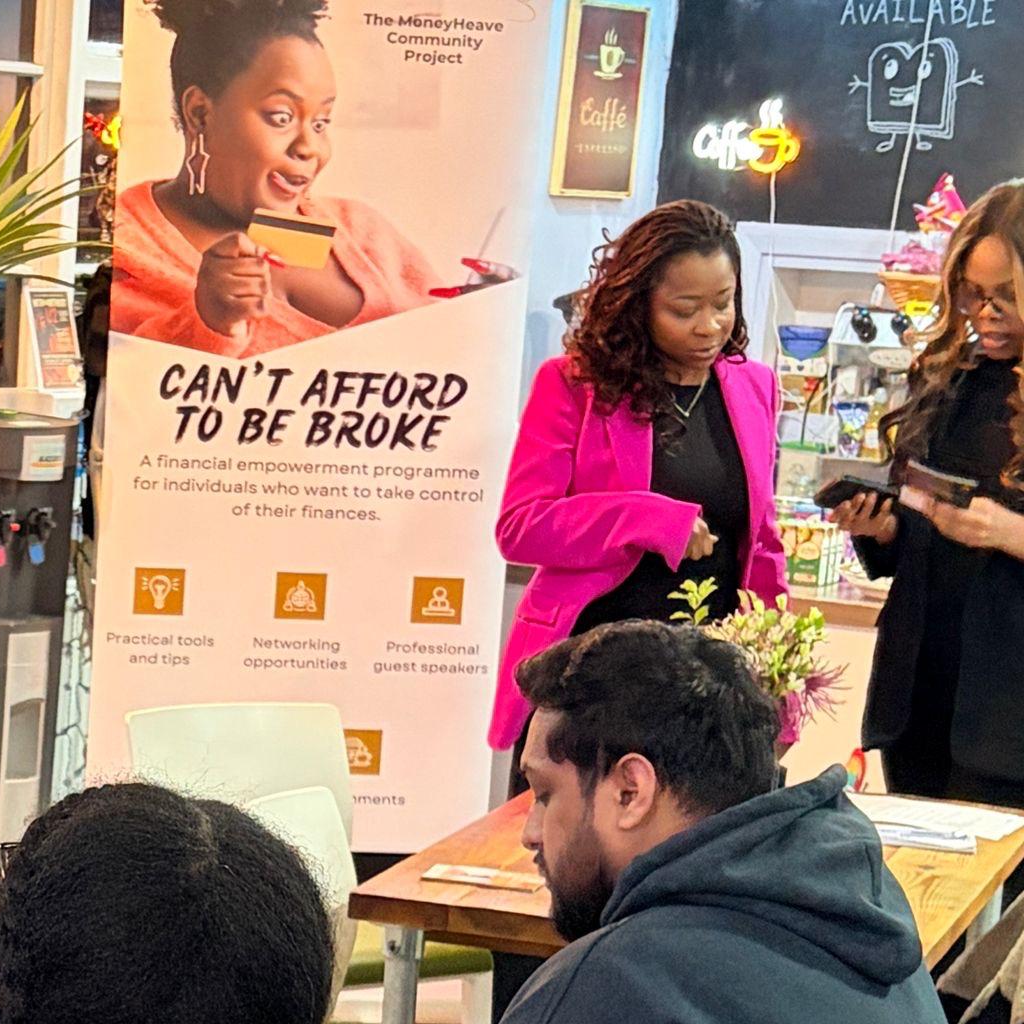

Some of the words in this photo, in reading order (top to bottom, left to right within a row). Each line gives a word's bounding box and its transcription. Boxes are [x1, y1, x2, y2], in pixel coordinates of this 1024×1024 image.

[363, 13, 394, 26] The
[398, 15, 504, 32] MoneyHeave
[840, 0, 996, 29] AVAILABLE
[387, 31, 483, 51] Community
[404, 49, 463, 66] Project
[579, 97, 627, 132] Caffé
[159, 362, 295, 407] CAN'T
[300, 369, 468, 412] AFFORD
[173, 405, 222, 445] TO
[237, 407, 295, 447] BE
[304, 410, 452, 452] BROKE
[139, 455, 152, 469] A
[157, 455, 232, 473] financial
[236, 458, 369, 478] empowerment
[373, 464, 480, 482] programme
[133, 477, 159, 491] for
[163, 477, 258, 496] individuals
[261, 480, 299, 497] who
[304, 484, 349, 499] want
[353, 485, 372, 499] to
[376, 486, 415, 501] take
[419, 488, 484, 503] control
[231, 502, 251, 517] of
[255, 503, 297, 519] their
[301, 505, 381, 521] finances.
[106, 632, 173, 647] Practical
[177, 634, 215, 648] tools
[252, 637, 341, 654] Networking
[386, 641, 480, 655] Professional
[128, 651, 158, 665] and
[161, 653, 191, 667] tips
[243, 656, 348, 672] opportunities
[373, 660, 416, 675] guest
[420, 661, 488, 677] speakers
